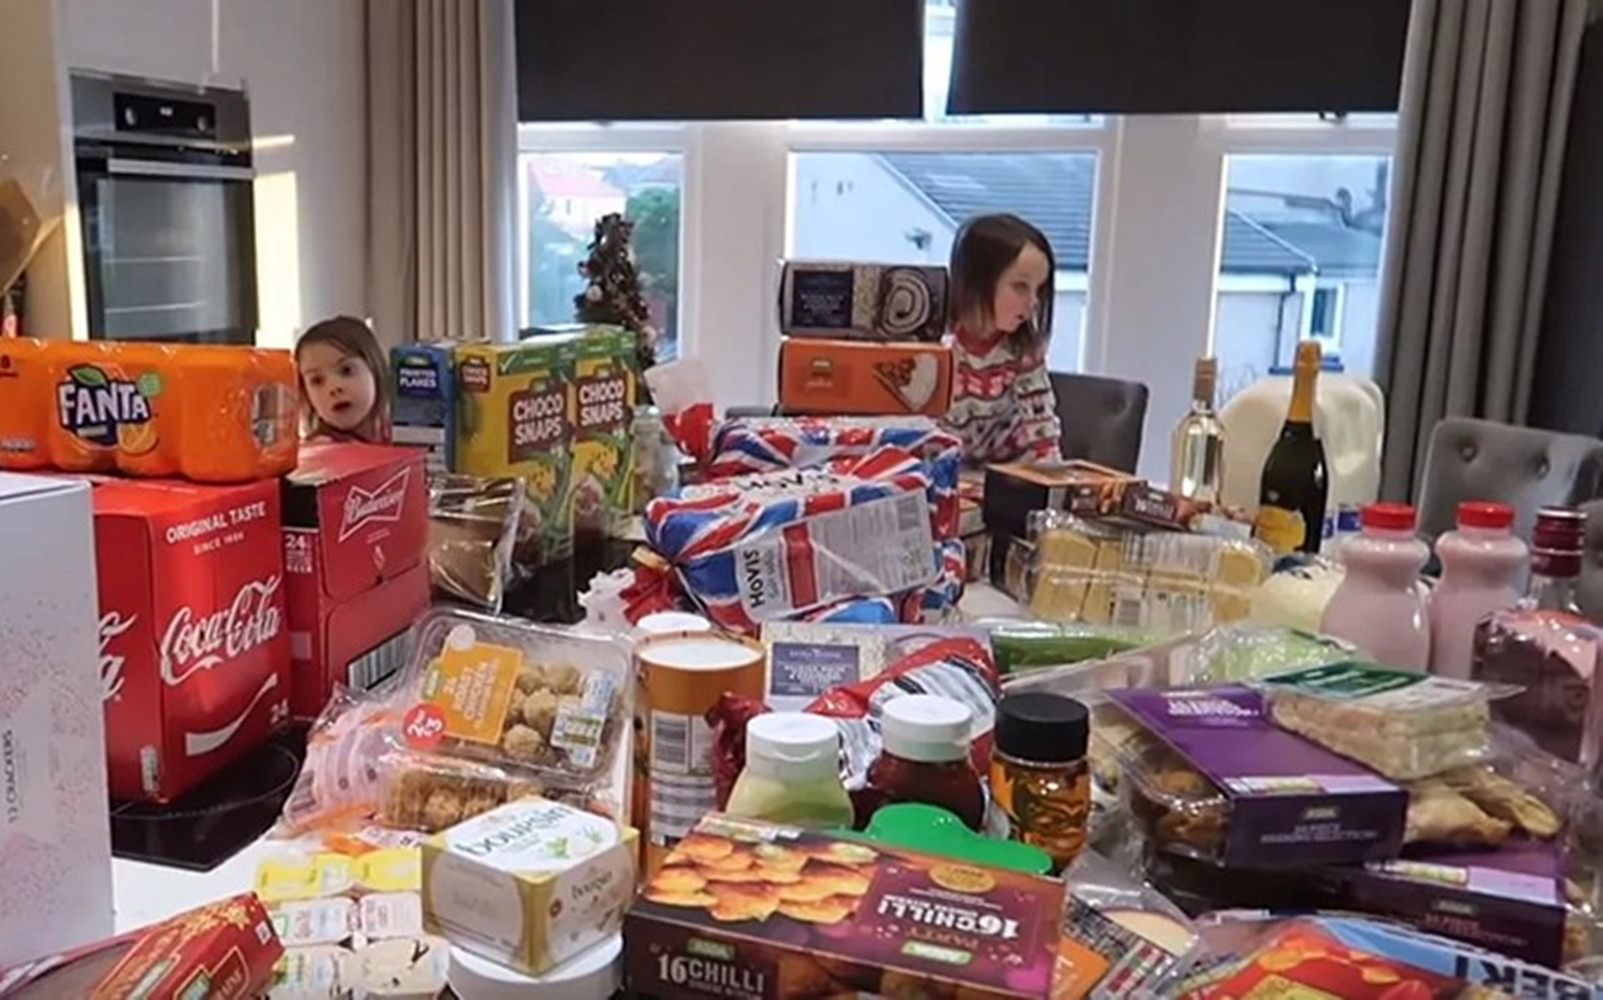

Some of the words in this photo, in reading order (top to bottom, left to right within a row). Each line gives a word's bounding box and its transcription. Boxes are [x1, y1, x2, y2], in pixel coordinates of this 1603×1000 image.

[58, 382, 150, 425] FANTA
[579, 379, 624, 404] CHOCO
[513, 394, 564, 422] CHOCO
[580, 401, 624, 426] SNAPS
[514, 416, 562, 445] SNAPS
[166, 513, 228, 544] ORIGINAL
[229, 502, 266, 524] TASTE
[285, 534, 306, 549] 24
[743, 549, 765, 609] HOVIS
[160, 573, 282, 686] Coca-Cola
[877, 899, 975, 931] CHILLI
[973, 914, 1020, 939] 16
[658, 953, 688, 984] 16
[688, 959, 765, 993] CHILLI
